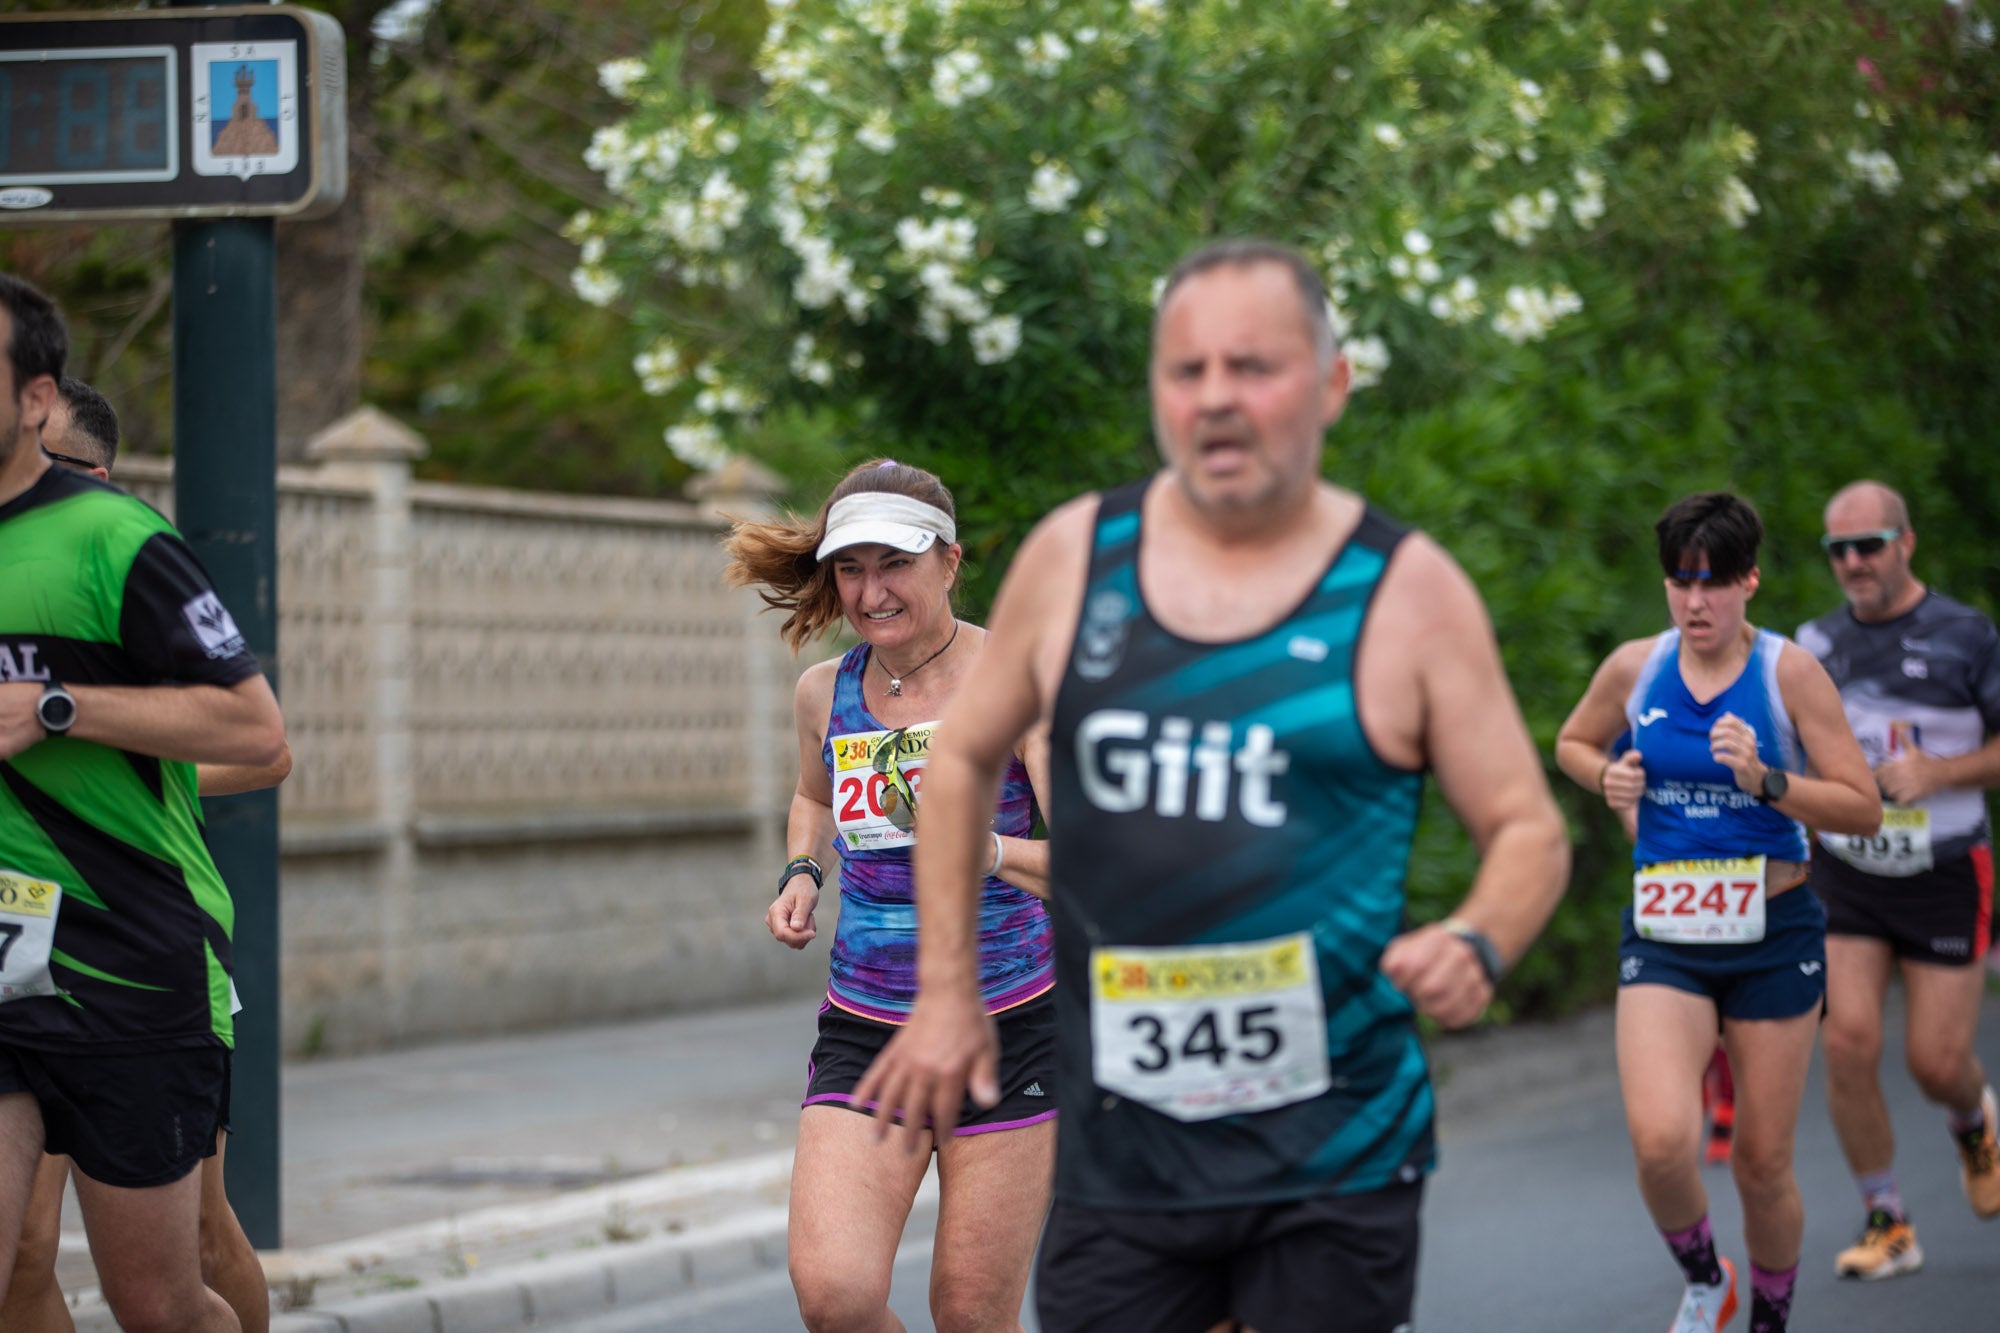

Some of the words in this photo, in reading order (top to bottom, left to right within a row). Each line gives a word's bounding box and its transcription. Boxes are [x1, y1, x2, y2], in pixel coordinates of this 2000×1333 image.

[1074, 707, 1291, 828] Giit
[1641, 882, 1758, 917] 2247
[1128, 1006, 1284, 1073] 345
